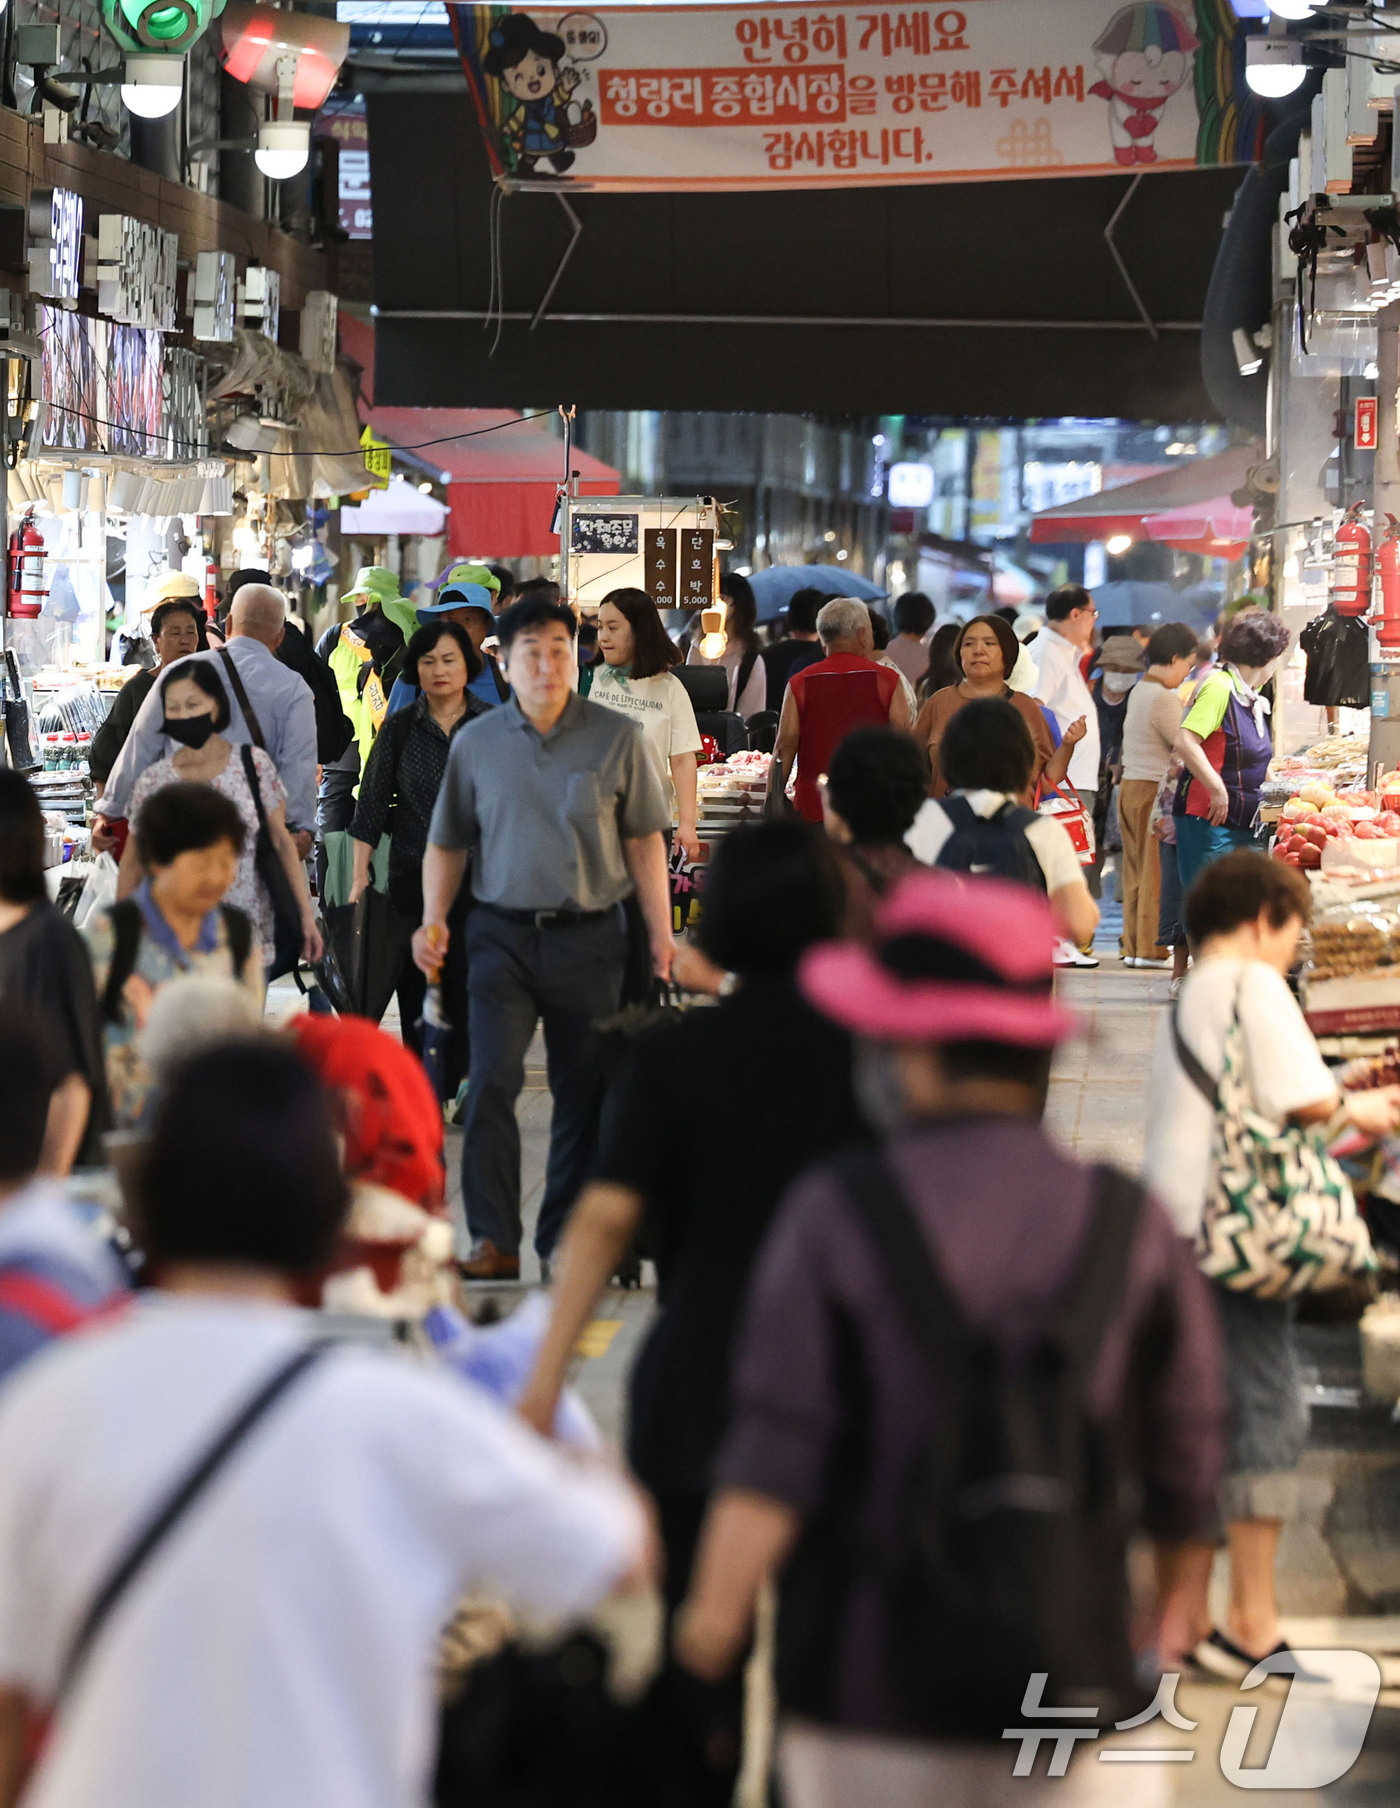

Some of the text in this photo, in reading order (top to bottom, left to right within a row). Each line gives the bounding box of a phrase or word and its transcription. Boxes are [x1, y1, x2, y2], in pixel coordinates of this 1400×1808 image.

[735, 9, 970, 64] 안녕히 가세요
[710, 72, 878, 117] 종합시장을
[884, 70, 981, 115] 방문해
[988, 64, 1085, 108] 주셔서
[762, 126, 933, 171] 감사합니다.
[655, 536, 666, 592] 옥수수
[689, 537, 703, 593] 단호박
[650, 596, 673, 605] .000
[611, 694, 620, 702] DE
